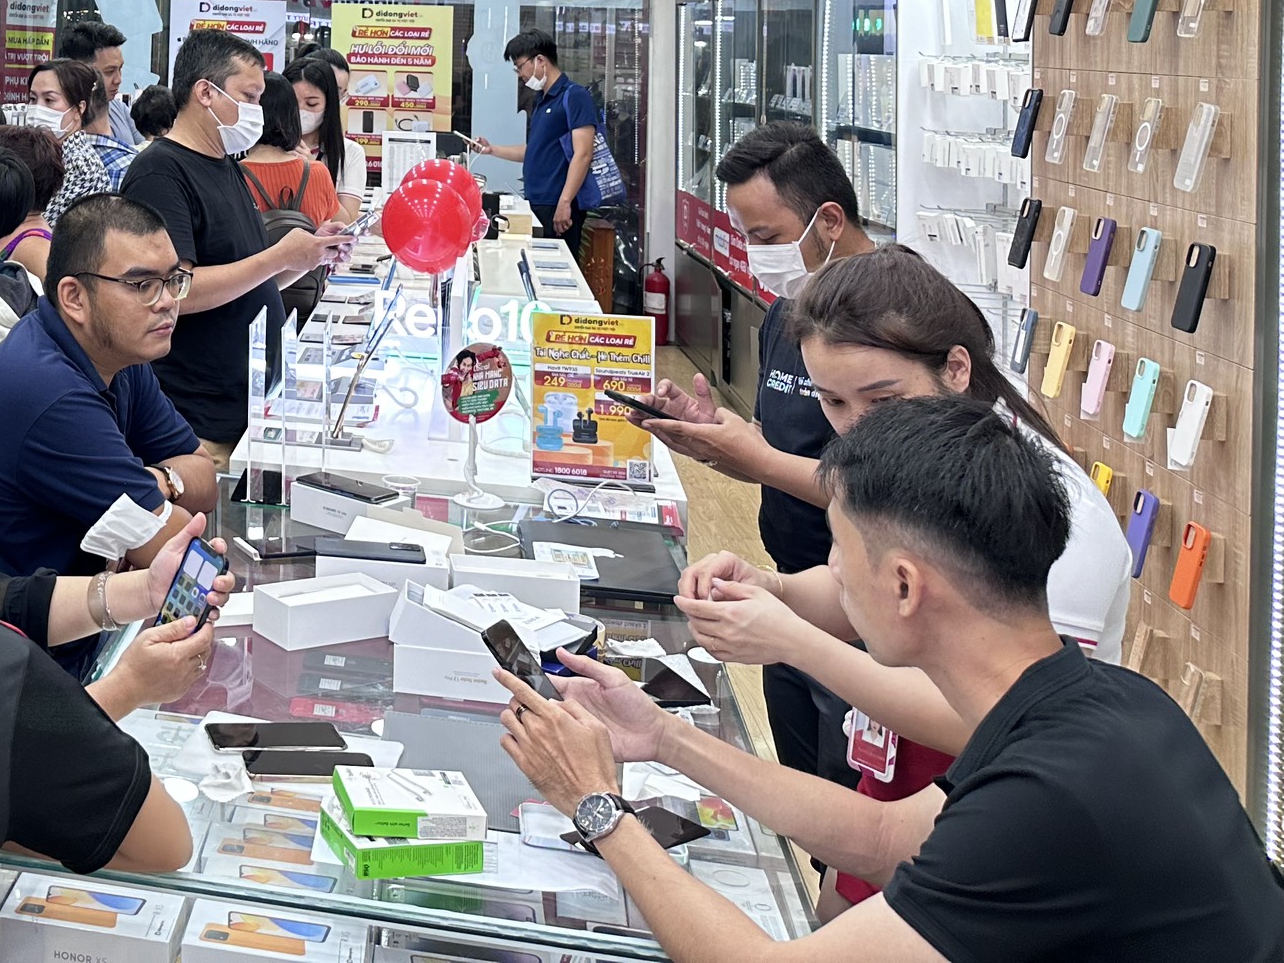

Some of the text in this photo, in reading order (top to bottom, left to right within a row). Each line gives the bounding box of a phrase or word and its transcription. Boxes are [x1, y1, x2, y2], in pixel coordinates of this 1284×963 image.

[10, 2, 49, 13] didongviet
[351, 55, 366, 63] BẢO
[367, 55, 390, 64] HÀNH
[391, 56, 407, 65] ĐẾN
[414, 57, 432, 65] NĂM
[770, 369, 793, 384] HOME
[767, 379, 792, 394] CREDIT
[572, 468, 587, 476] 6018
[54, 950, 92, 963] HONOR
